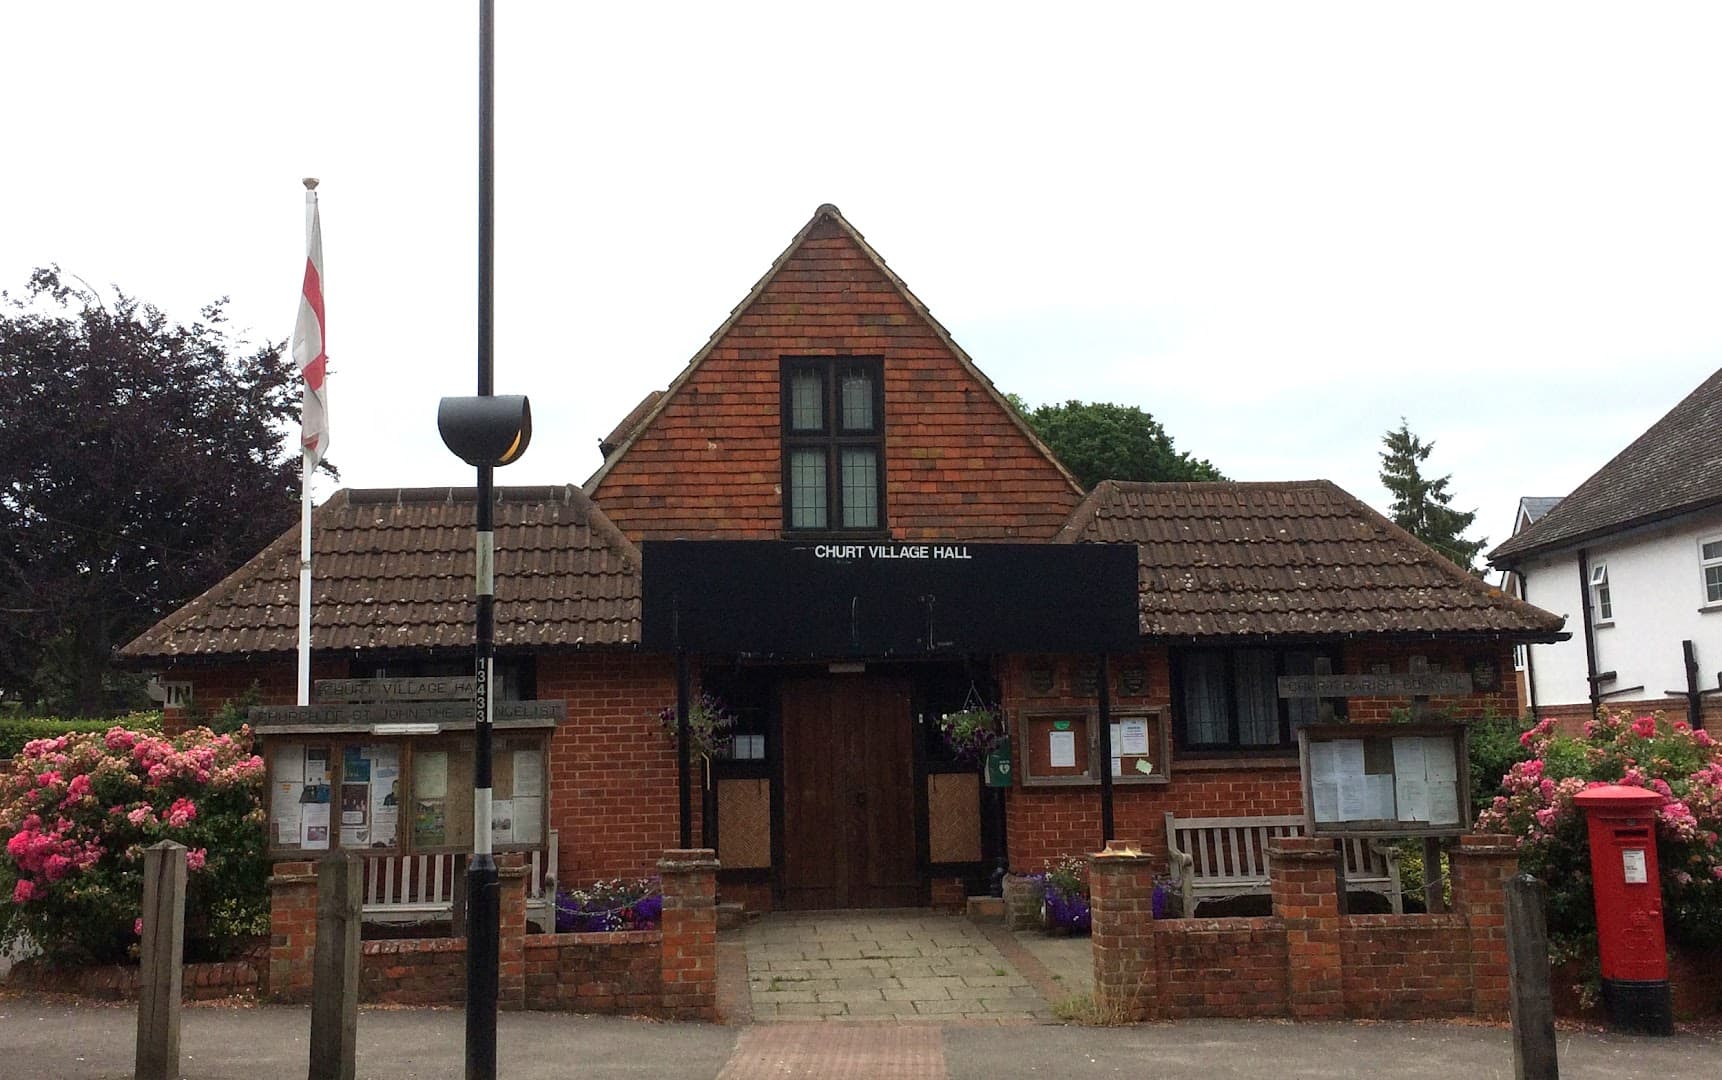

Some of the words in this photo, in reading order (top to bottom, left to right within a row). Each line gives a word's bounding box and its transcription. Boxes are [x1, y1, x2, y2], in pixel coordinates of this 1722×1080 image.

[815, 545, 864, 558] CHURT
[869, 546, 928, 558] VILLAGE
[934, 546, 972, 559] HALL
[383, 682, 447, 695] VILLAGE
[476, 657, 487, 722] 13433
[382, 708, 418, 720] JOHN
[427, 707, 454, 719] THE
